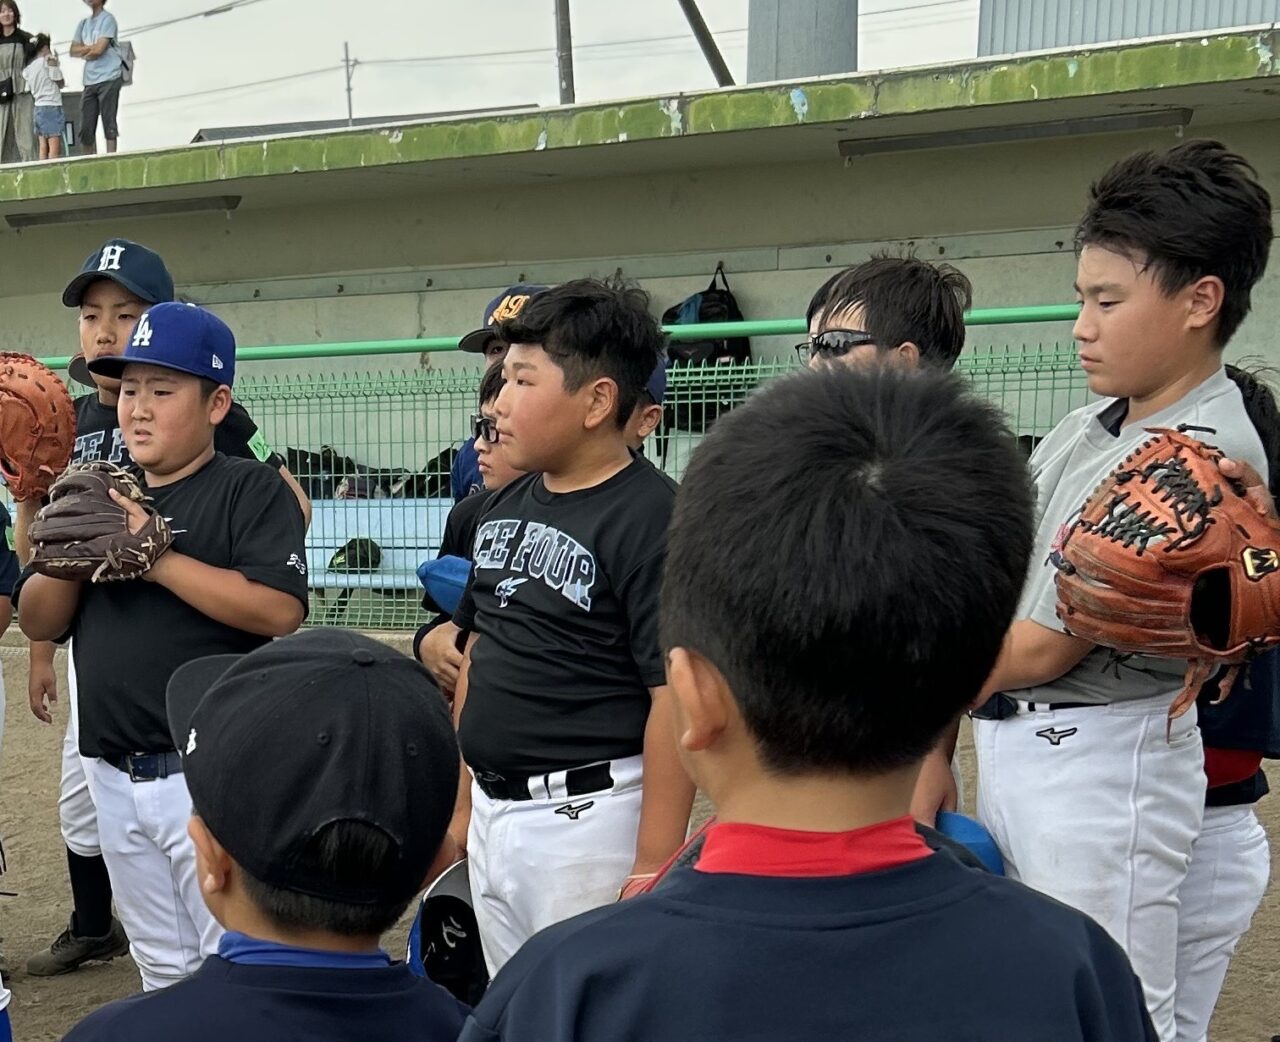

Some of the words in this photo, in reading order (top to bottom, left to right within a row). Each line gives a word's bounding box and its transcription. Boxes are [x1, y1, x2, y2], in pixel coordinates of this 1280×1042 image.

[97, 245, 125, 271] H
[132, 313, 152, 347] LA
[510, 522, 596, 612] FOUR
